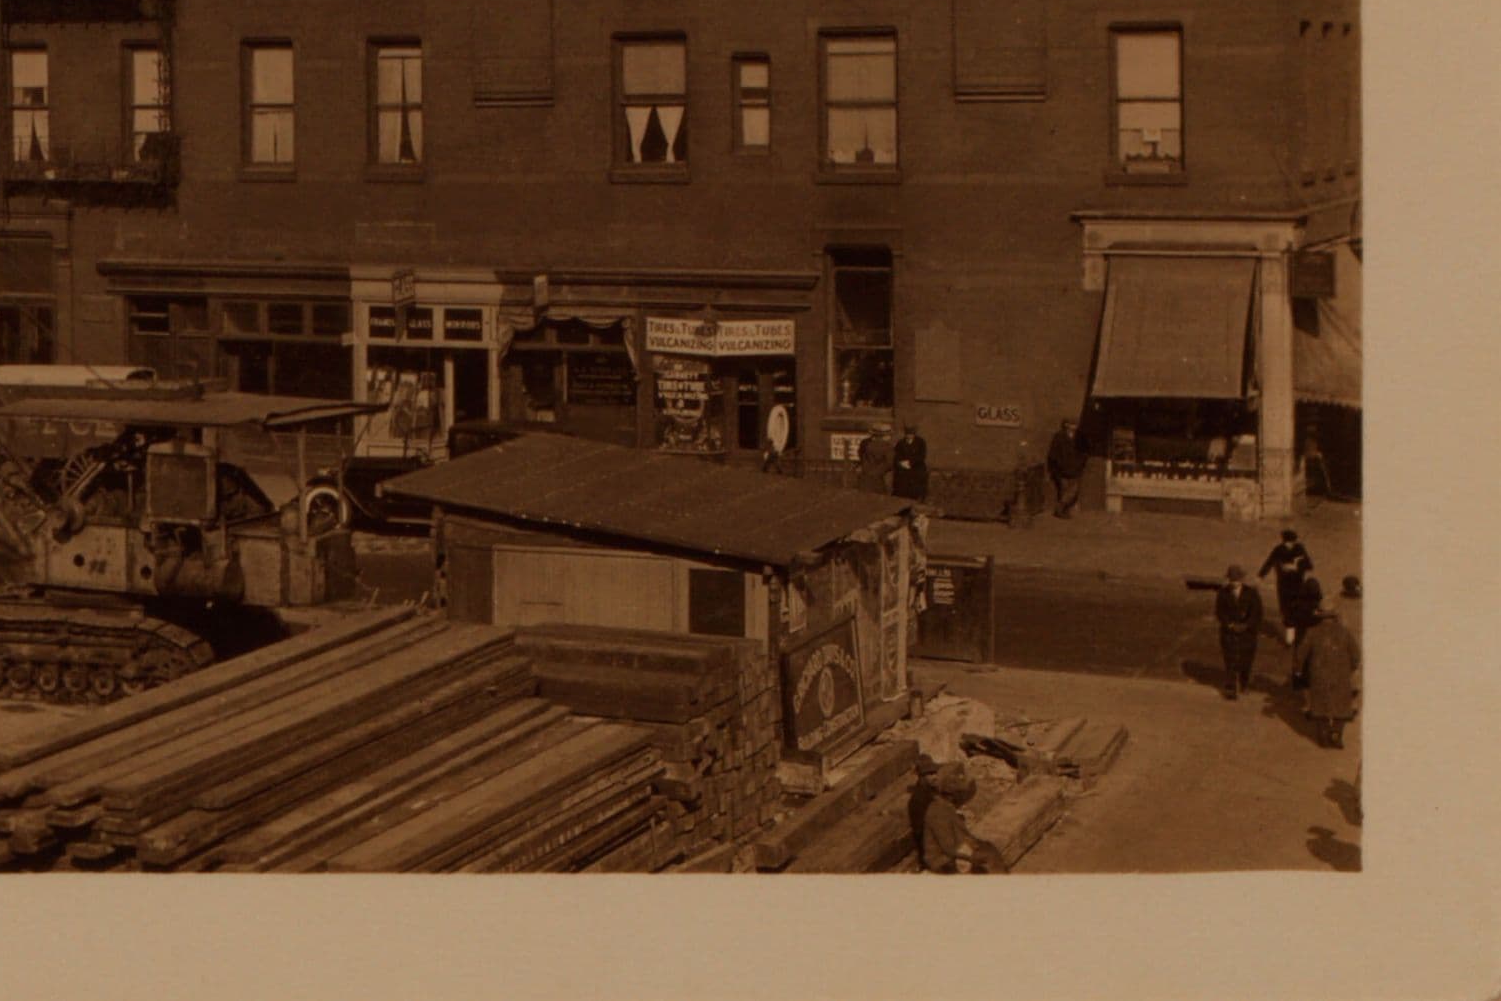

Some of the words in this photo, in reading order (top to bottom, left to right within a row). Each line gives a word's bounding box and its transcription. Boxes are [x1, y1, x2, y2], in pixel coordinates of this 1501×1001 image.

[649, 321, 674, 335] TIRES
[718, 326, 748, 337] TIRES
[755, 324, 792, 337] TUBES
[649, 337, 714, 351] VULCANIZING
[718, 340, 792, 352] VULCANIZING
[977, 406, 1021, 423] GLASS
